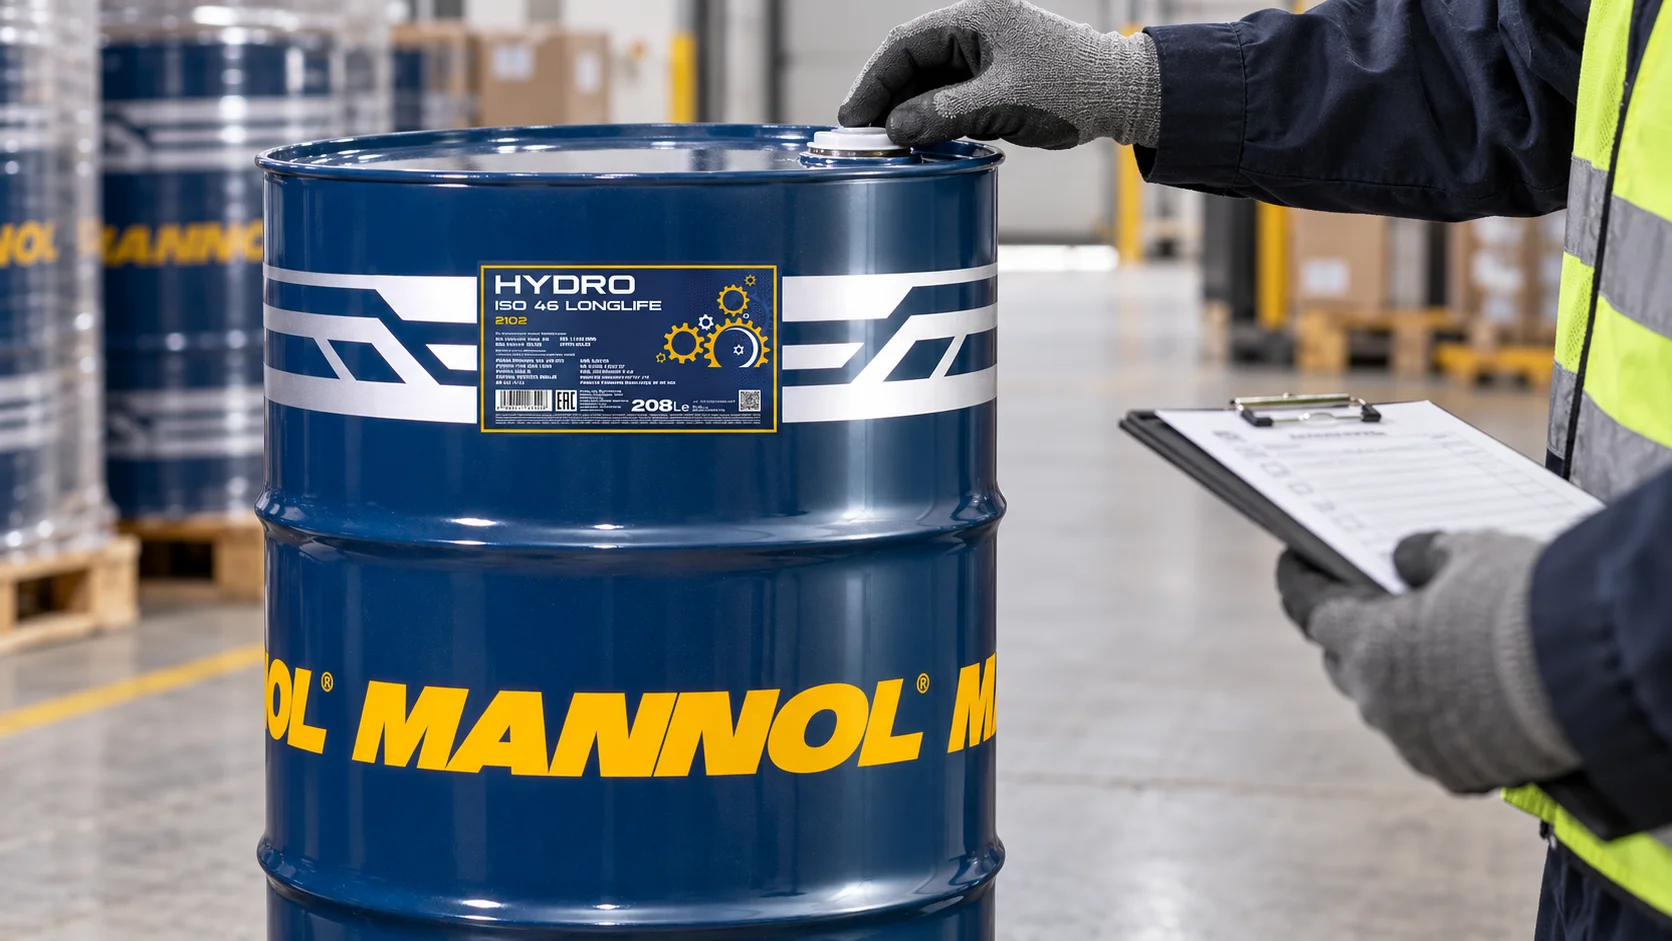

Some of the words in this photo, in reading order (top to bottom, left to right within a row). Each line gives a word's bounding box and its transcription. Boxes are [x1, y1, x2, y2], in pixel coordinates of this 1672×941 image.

[495, 275, 636, 294] HYDRO
[495, 301, 527, 311] ISO
[534, 301, 560, 311] 46
[565, 301, 662, 311] LONGLIFE
[495, 316, 528, 325] 2102
[557, 391, 576, 411] EAC
[947, 652, 997, 754] M
